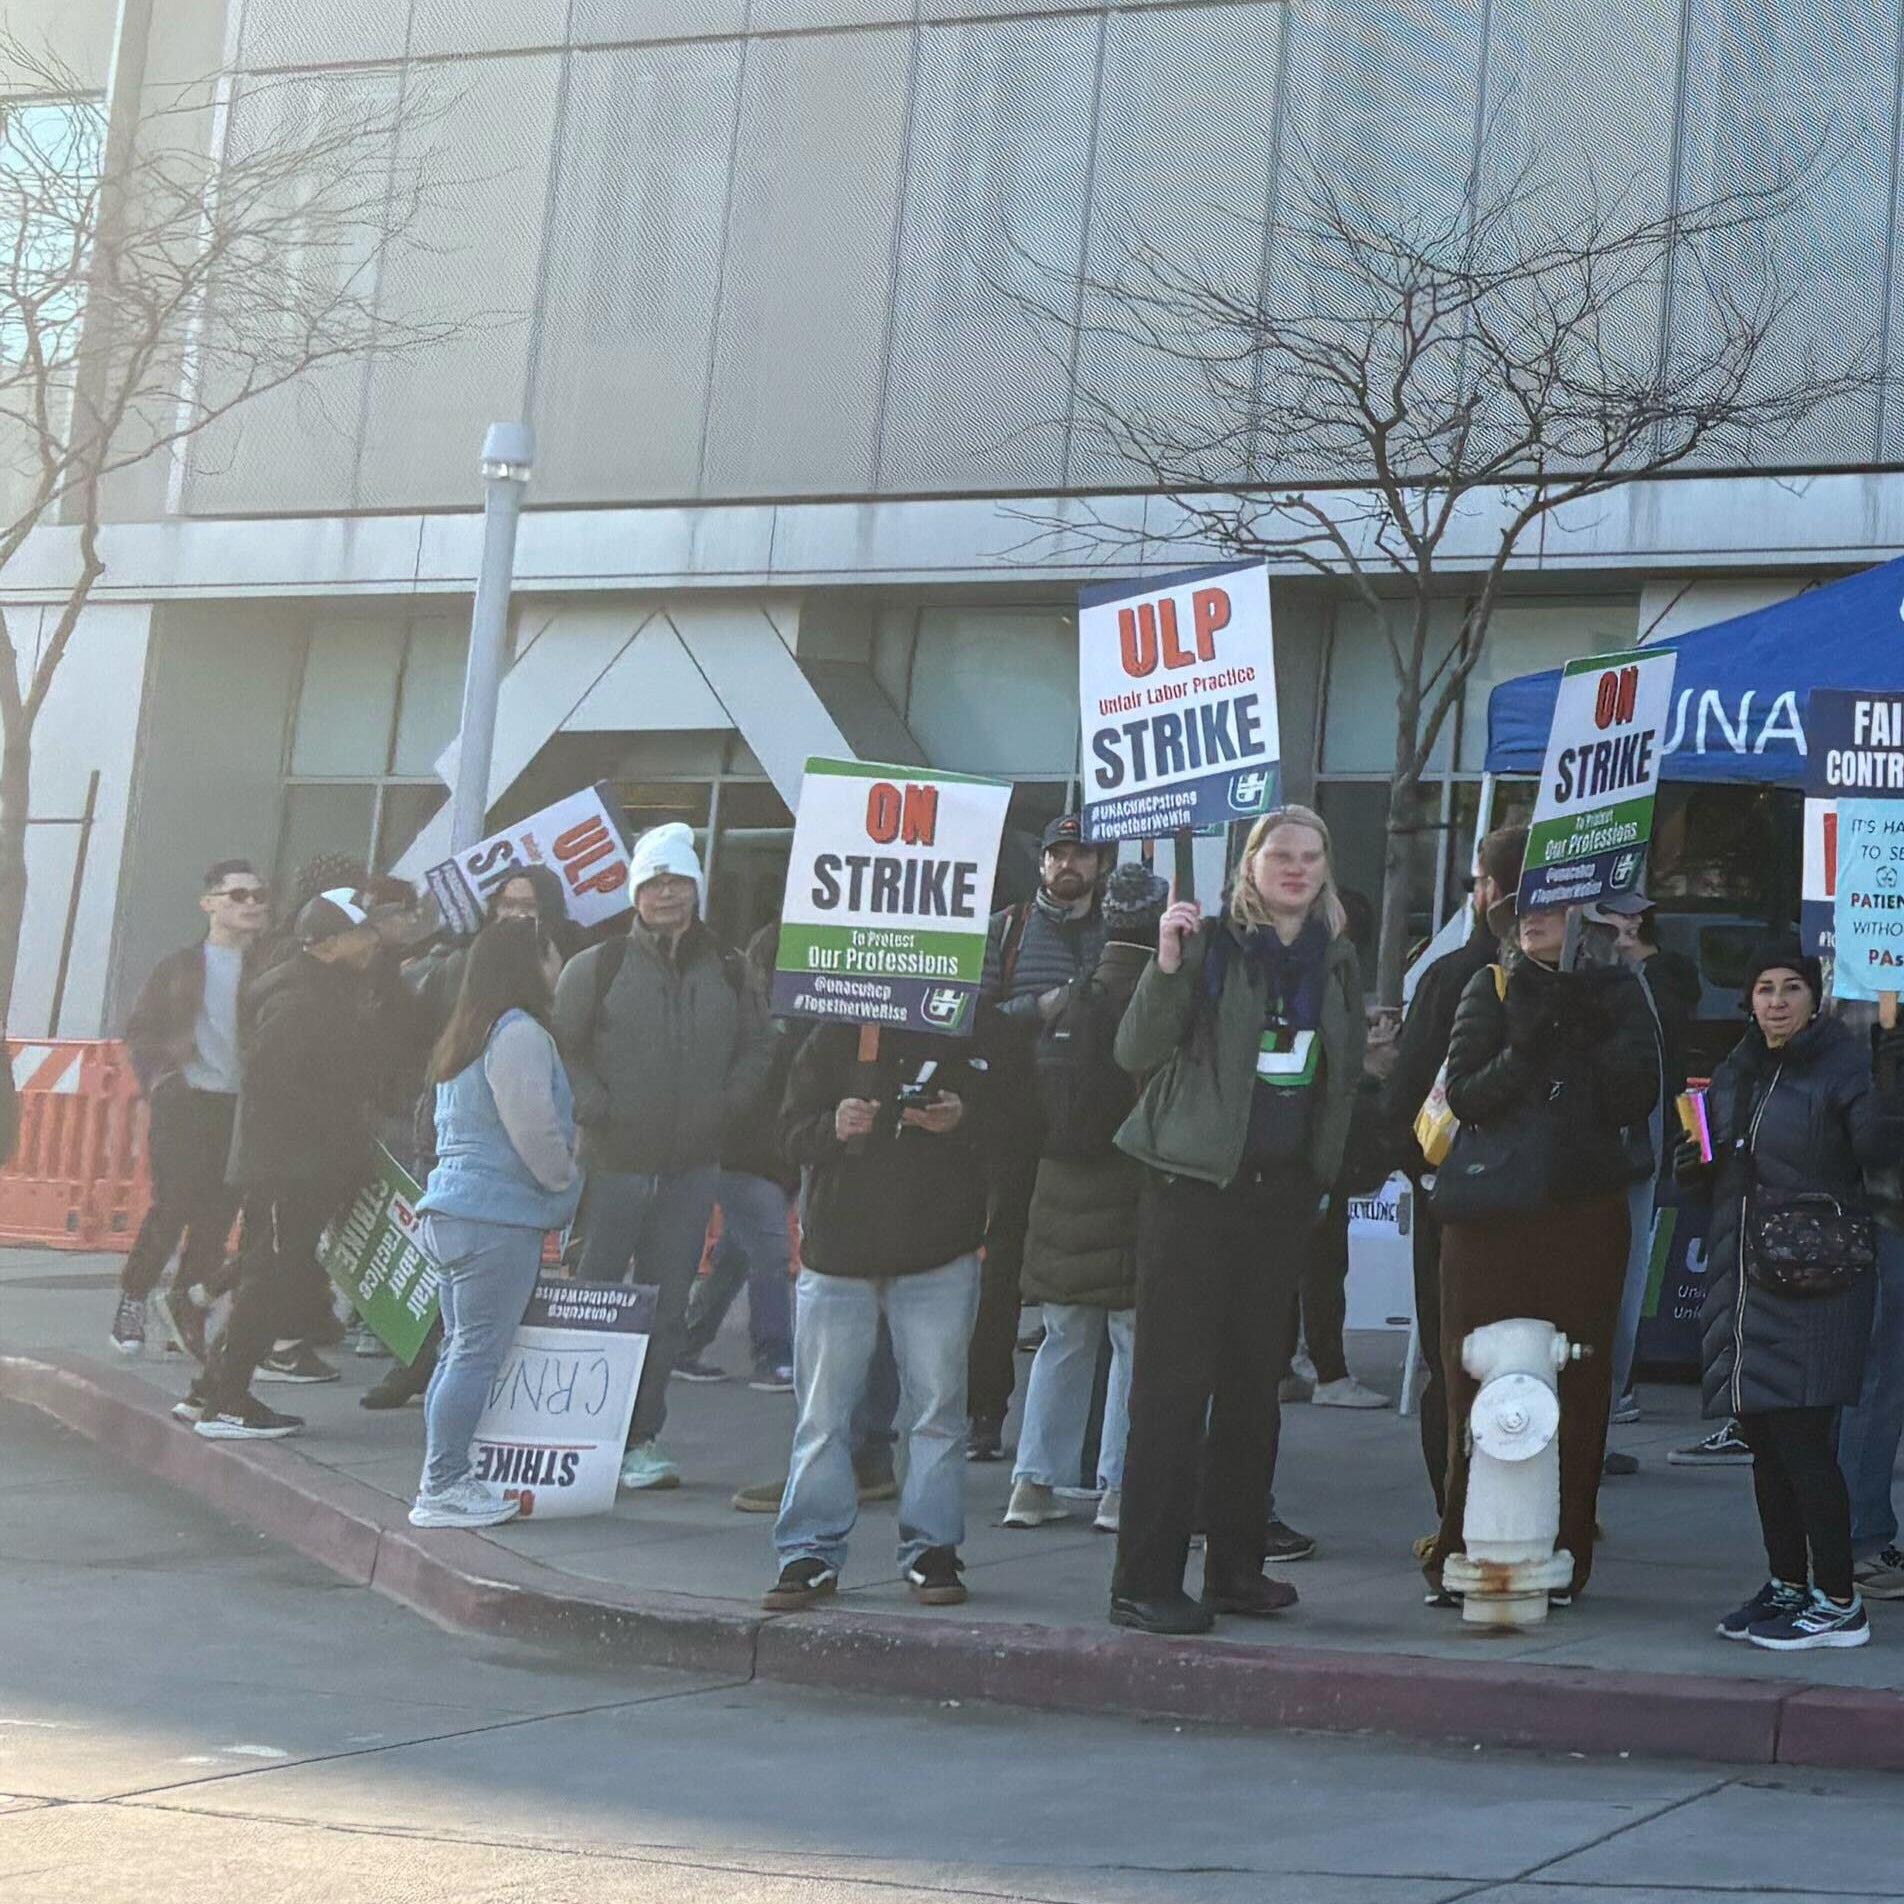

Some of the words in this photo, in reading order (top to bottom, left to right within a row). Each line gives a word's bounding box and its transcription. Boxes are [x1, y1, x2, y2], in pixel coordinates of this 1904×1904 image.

[1118, 586, 1232, 678] ULP
[1099, 691, 1142, 716] Unfair
[1147, 681, 1188, 705] Labor
[1193, 666, 1255, 694] Practice
[1594, 665, 1638, 729] ON
[1092, 693, 1265, 790] STRIKE
[1554, 729, 1655, 804] STRIKE
[866, 782, 939, 846] ON
[1567, 820, 1637, 855] Professions
[1851, 819, 1876, 834] IT'S
[552, 814, 627, 896] ULP
[1862, 845, 1881, 860] TO
[812, 853, 978, 918] STRIKE
[808, 946, 840, 969] Our
[846, 949, 959, 975] Professions
[1869, 950, 1904, 966] PAs
[476, 1445, 580, 1486] STRIKE
